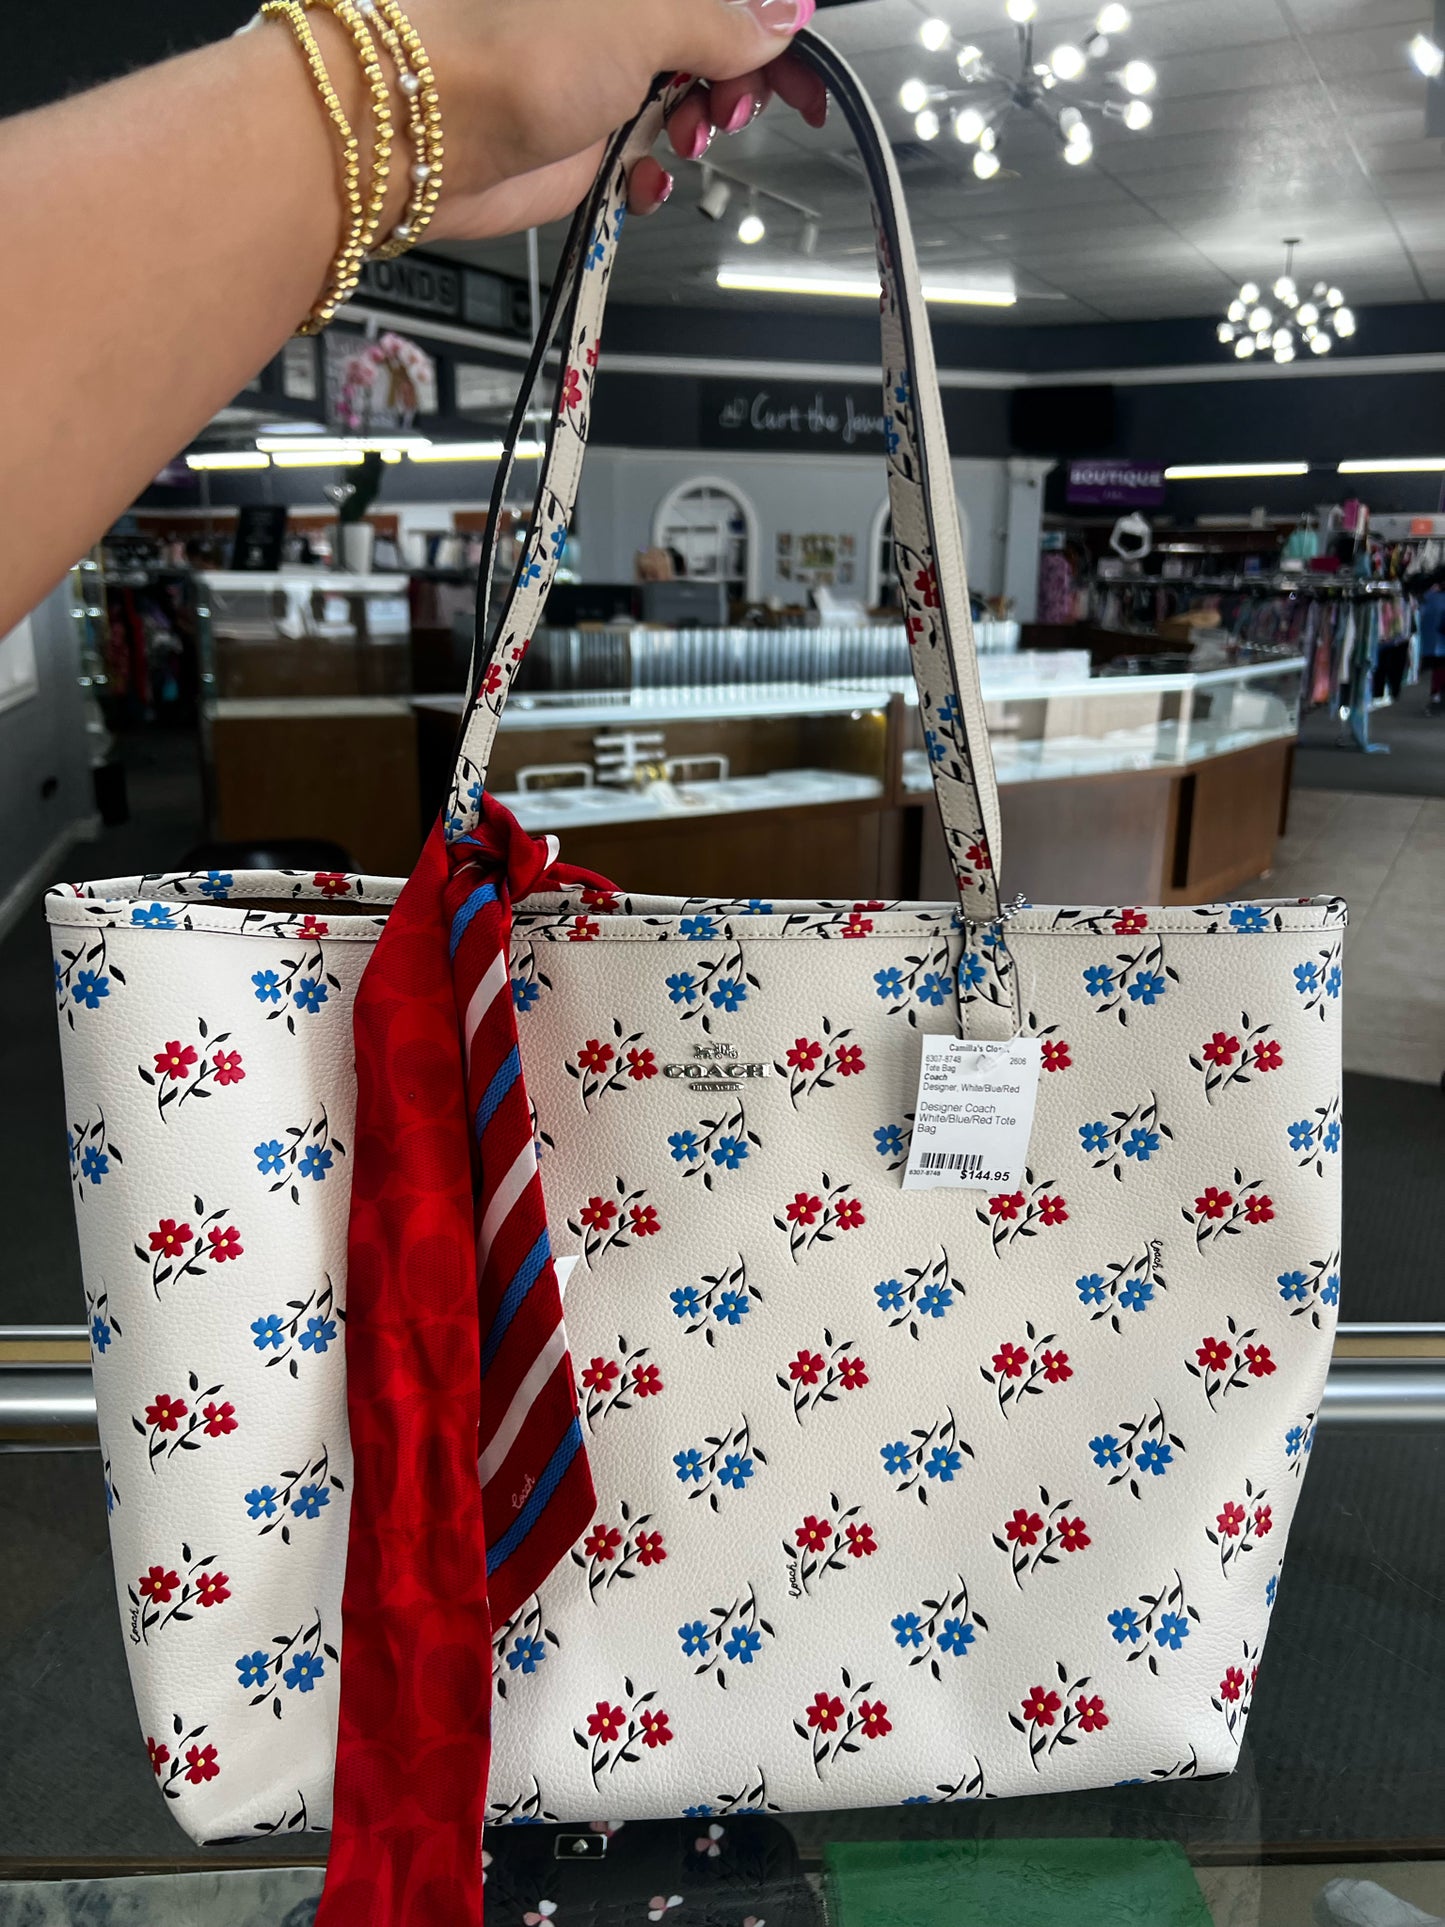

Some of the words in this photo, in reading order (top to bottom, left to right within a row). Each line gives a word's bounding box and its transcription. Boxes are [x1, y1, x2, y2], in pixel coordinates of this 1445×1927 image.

[750, 391, 803, 432] Curt
[805, 392, 842, 433] the
[843, 394, 885, 443] Jewe
[1070, 469, 1162, 488] BOUTIQUE
[949, 1043, 984, 1052] Camilla's
[986, 1044, 1010, 1054] Clo
[925, 1054, 962, 1064] 6307-8748
[663, 1062, 771, 1078] COACH
[925, 1063, 940, 1072] Tote
[941, 1064, 956, 1073] Bag
[924, 1072, 948, 1081] Coach
[961, 1083, 1020, 1093] White/Blue/Red
[920, 1101, 963, 1114] Designer
[965, 1102, 996, 1113] Coach
[918, 1113, 993, 1125] White/Blue/Red
[995, 1115, 1016, 1126] Tote
[917, 1123, 936, 1135] Bag
[909, 1169, 941, 1177] 6307-8748
[960, 1169, 1010, 1181] $144.95
[1150, 1238, 1163, 1271] Coach
[511, 1473, 536, 1509] Coach
[786, 1561, 802, 1599] Coach
[129, 1607, 141, 1645] Coach
